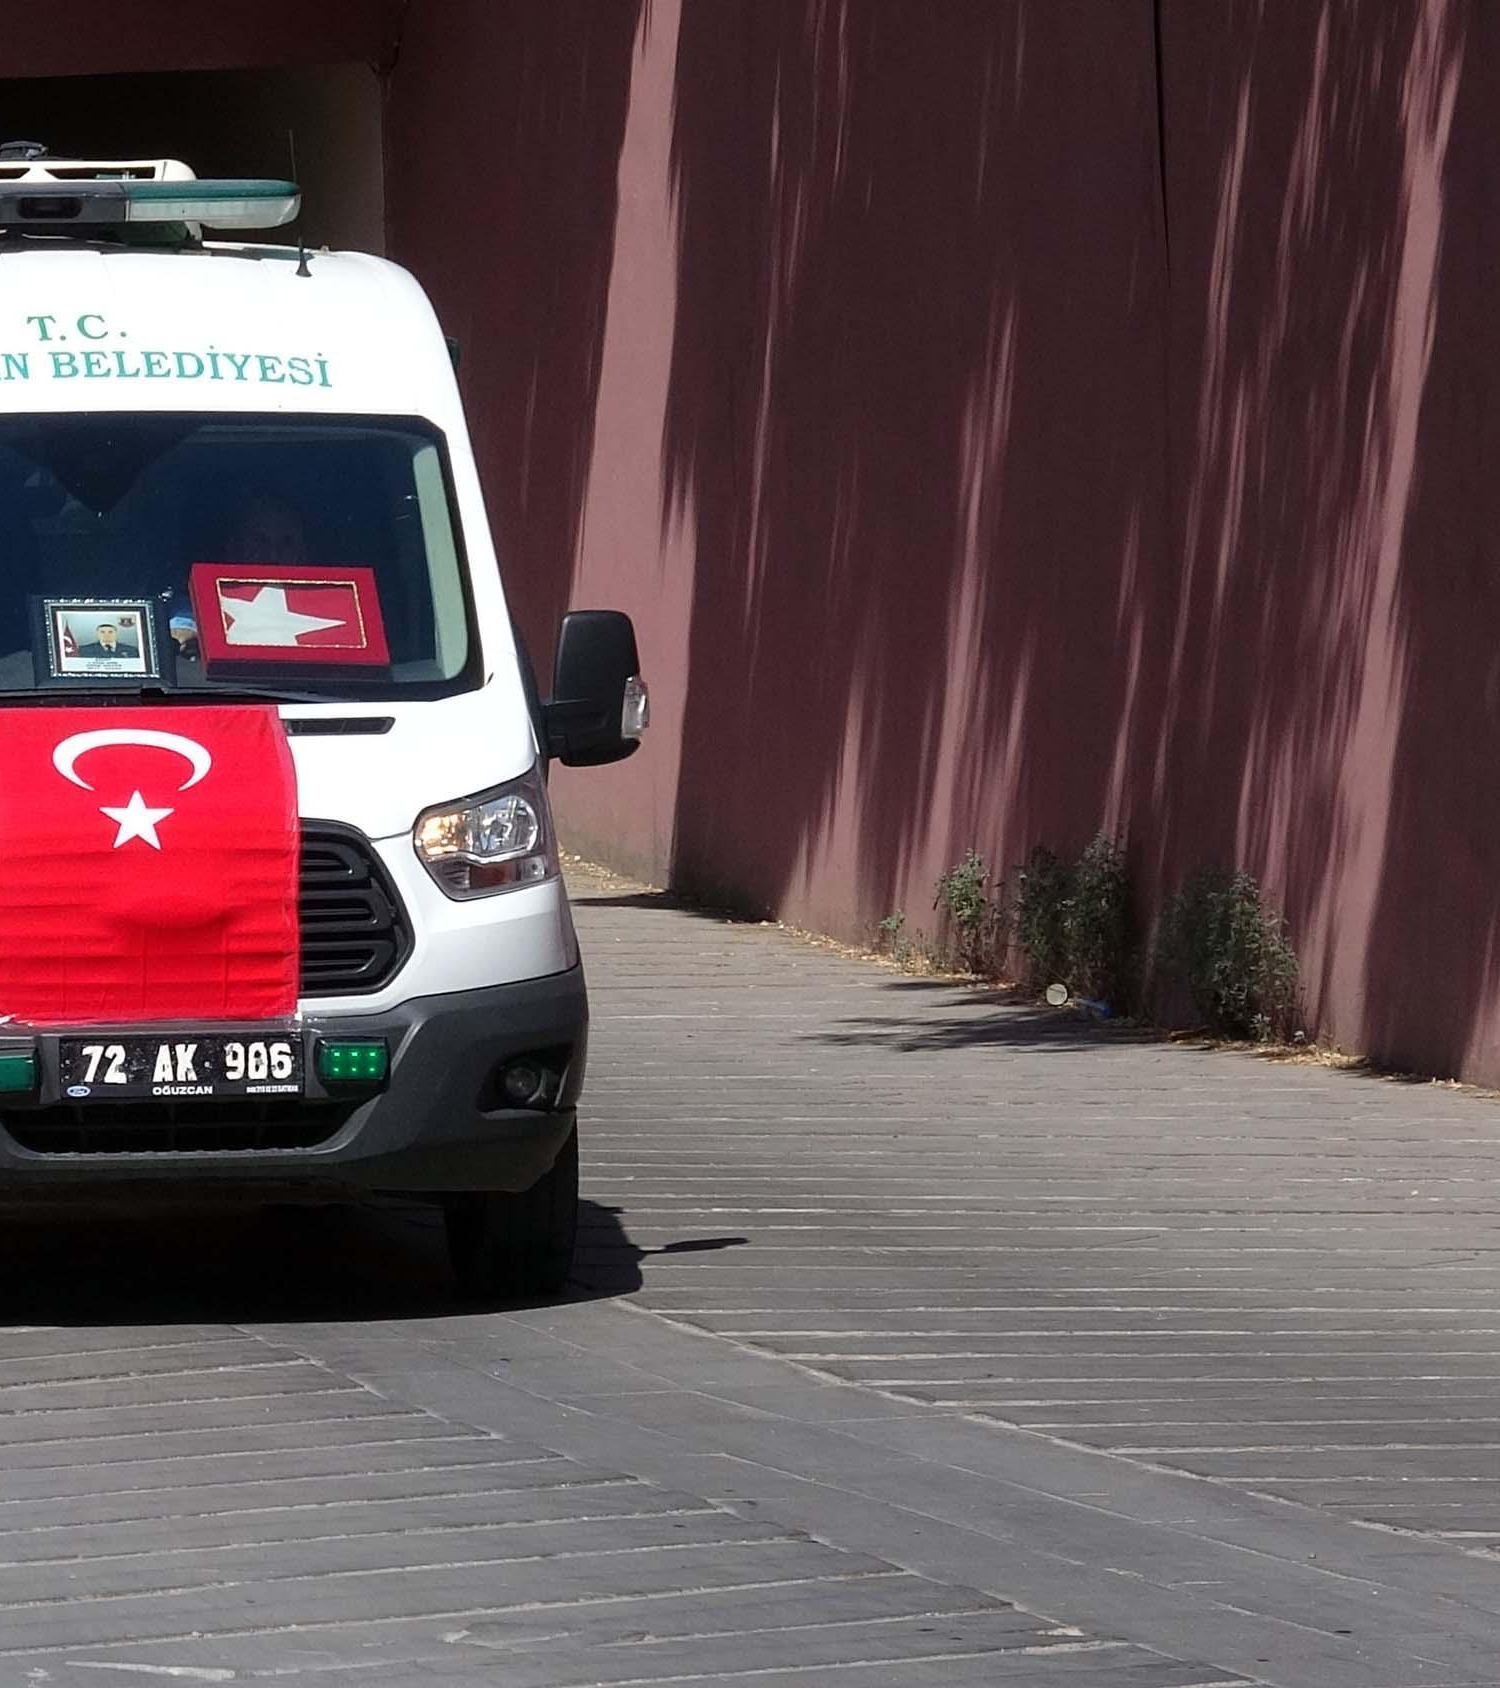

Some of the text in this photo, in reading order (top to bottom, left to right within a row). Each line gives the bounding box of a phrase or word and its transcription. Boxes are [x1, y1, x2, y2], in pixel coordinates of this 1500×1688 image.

[47, 345, 334, 388] BELEDİYESİ
[82, 1044, 128, 1084] 72
[152, 1043, 198, 1083] AK
[152, 1085, 213, 1096] OĞUZCAN
